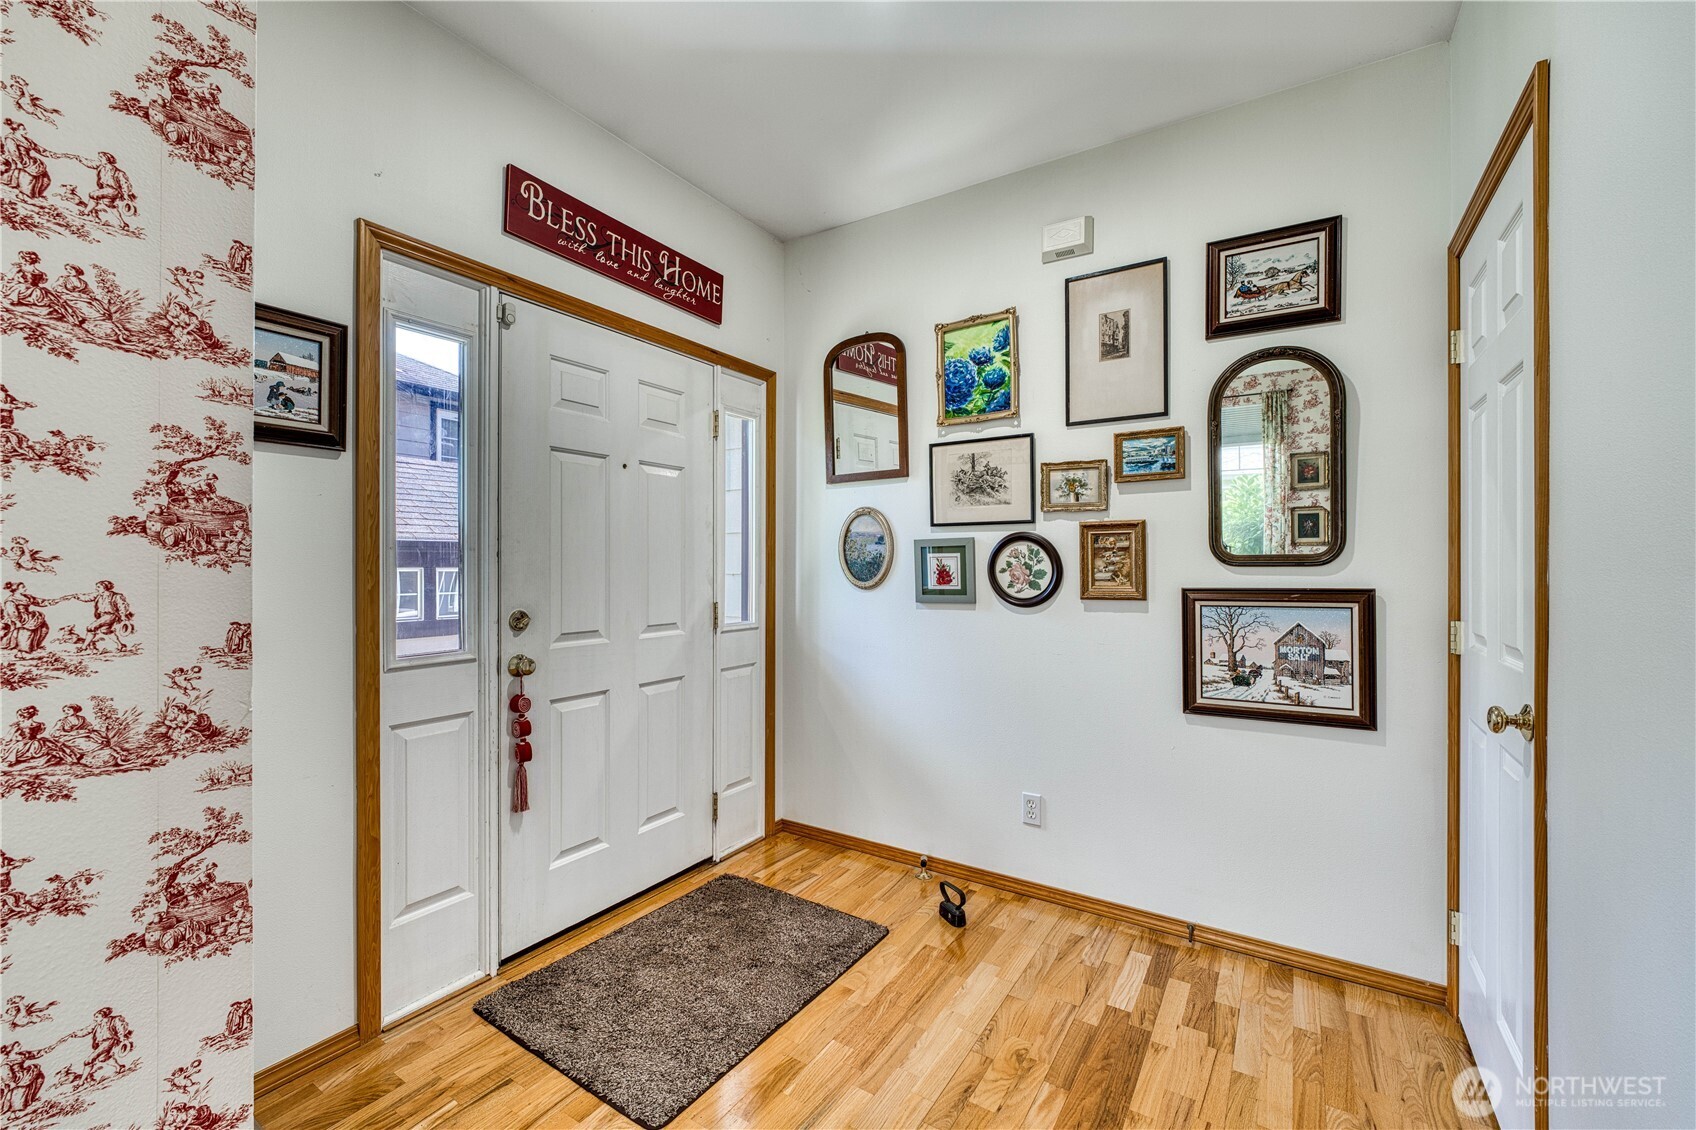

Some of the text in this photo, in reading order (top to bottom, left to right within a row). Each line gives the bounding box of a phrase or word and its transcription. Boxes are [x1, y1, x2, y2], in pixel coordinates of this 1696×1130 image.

[520, 180, 722, 305] BLESS THIS HOME
[557, 237, 697, 306] with love and laughter
[1279, 645, 1320, 655] MORTON
[1287, 653, 1310, 662] SALT
